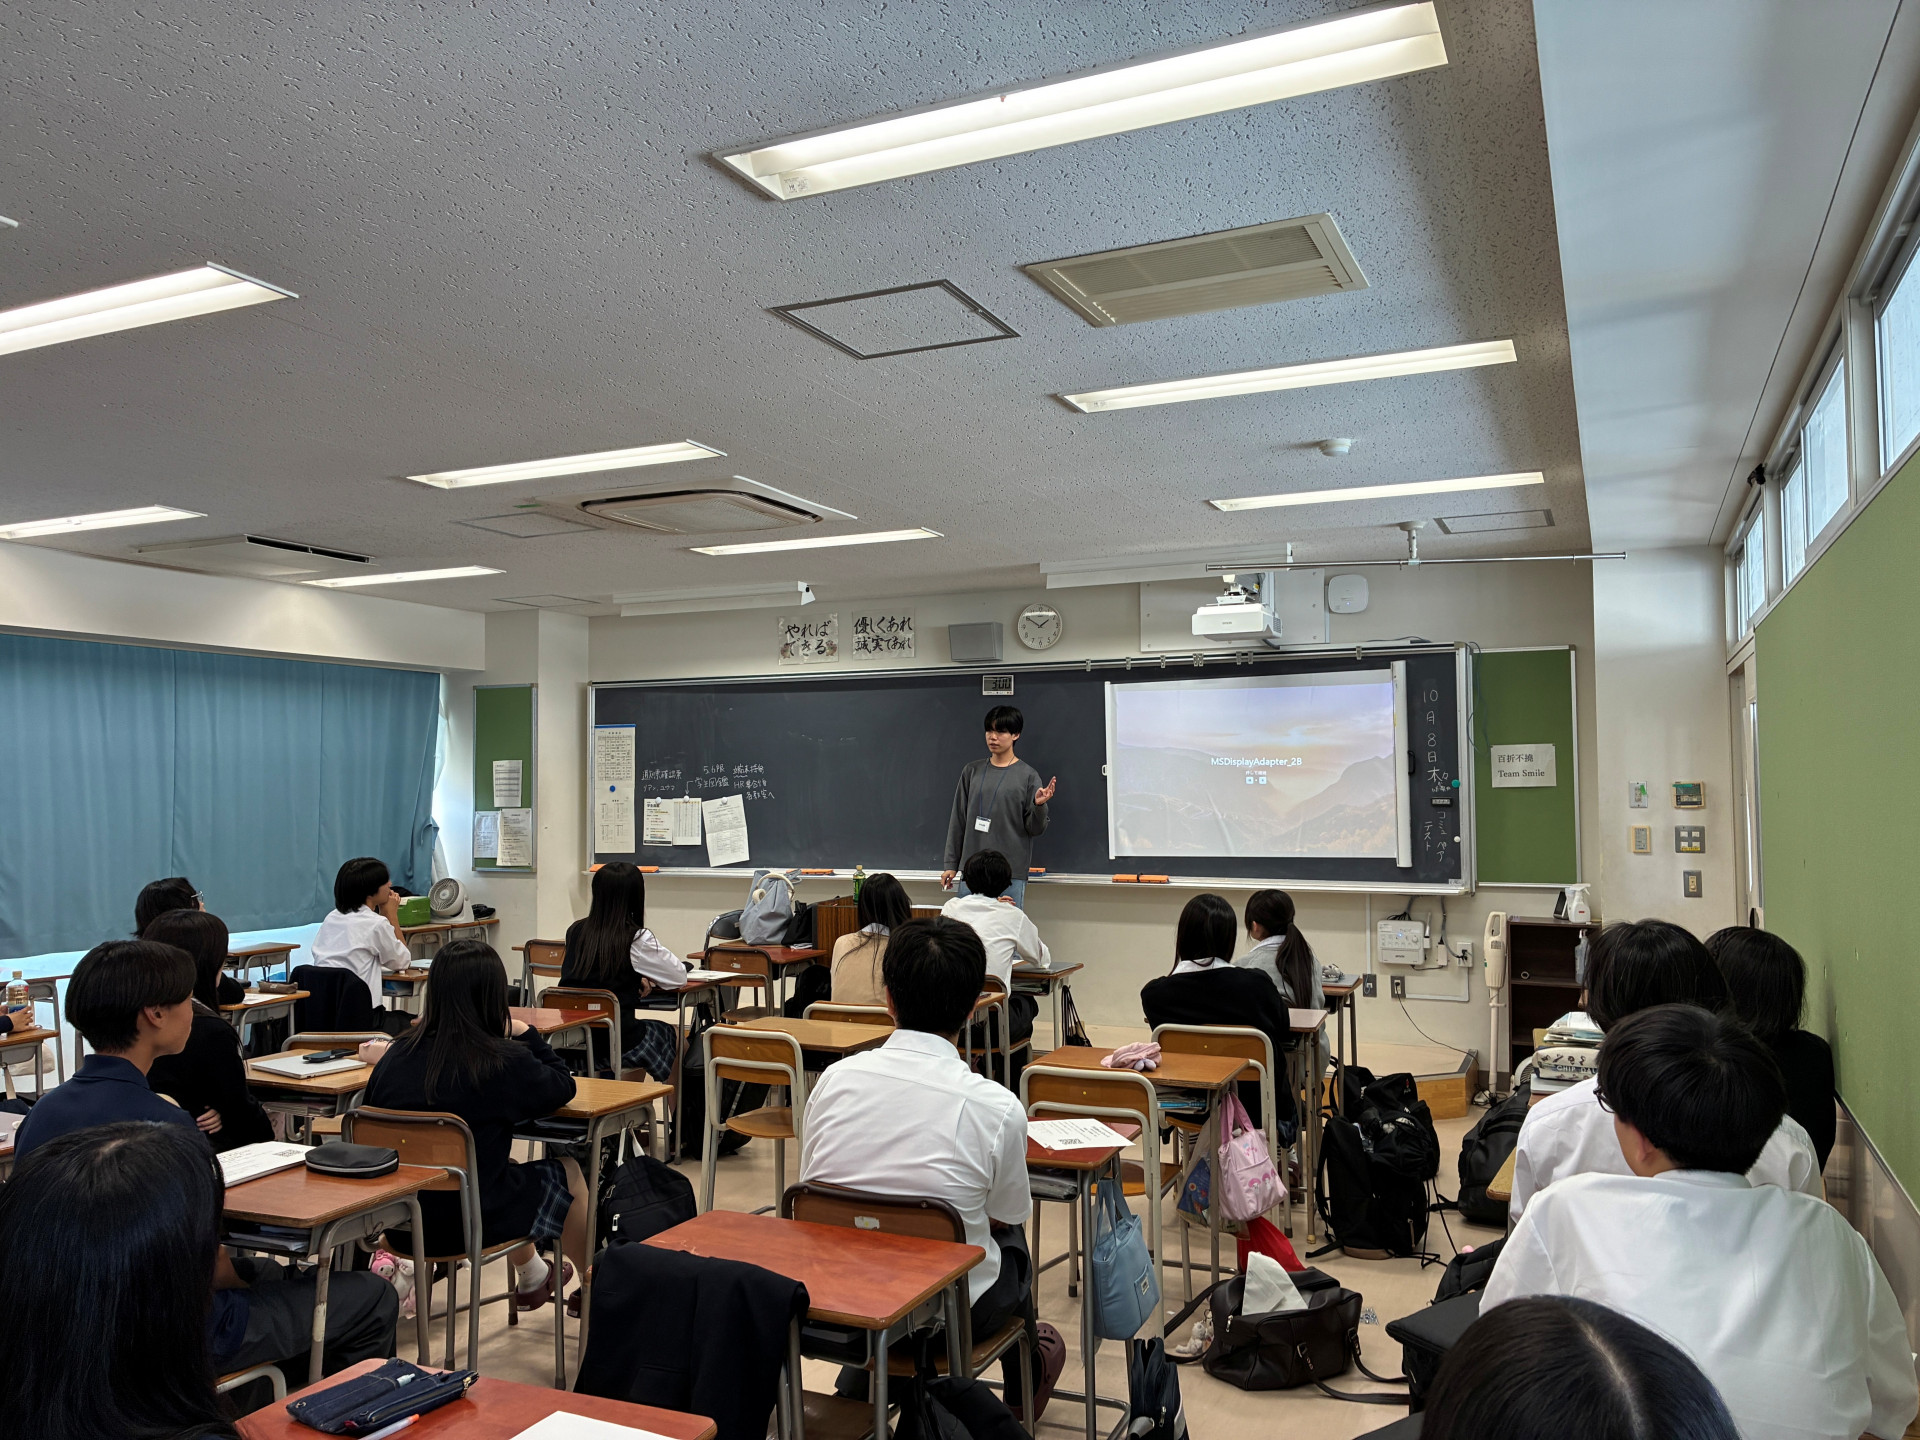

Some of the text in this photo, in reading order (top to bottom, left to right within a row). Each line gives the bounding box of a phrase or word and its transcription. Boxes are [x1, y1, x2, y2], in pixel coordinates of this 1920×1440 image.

[785, 620, 831, 638] やれば
[854, 617, 912, 635] 優しくあれ
[784, 638, 826, 657] できる
[855, 636, 912, 654] 誠実であれ
[1497, 768, 1545, 778] Team Smile
